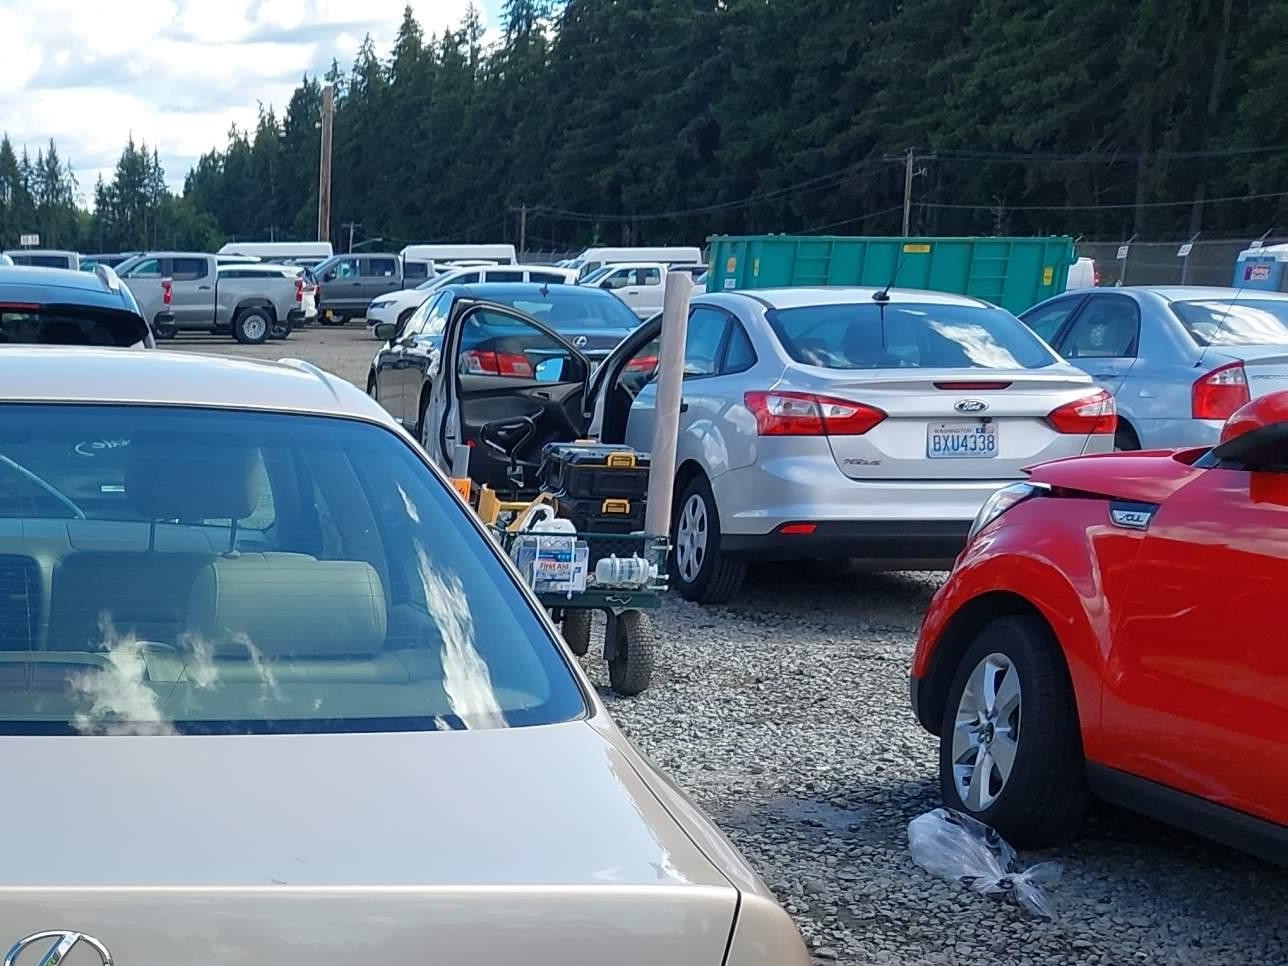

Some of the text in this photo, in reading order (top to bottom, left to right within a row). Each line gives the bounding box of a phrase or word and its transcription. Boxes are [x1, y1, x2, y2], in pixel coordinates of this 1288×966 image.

[933, 434, 995, 452] BXU4338
[539, 562, 569, 571] First Aid
